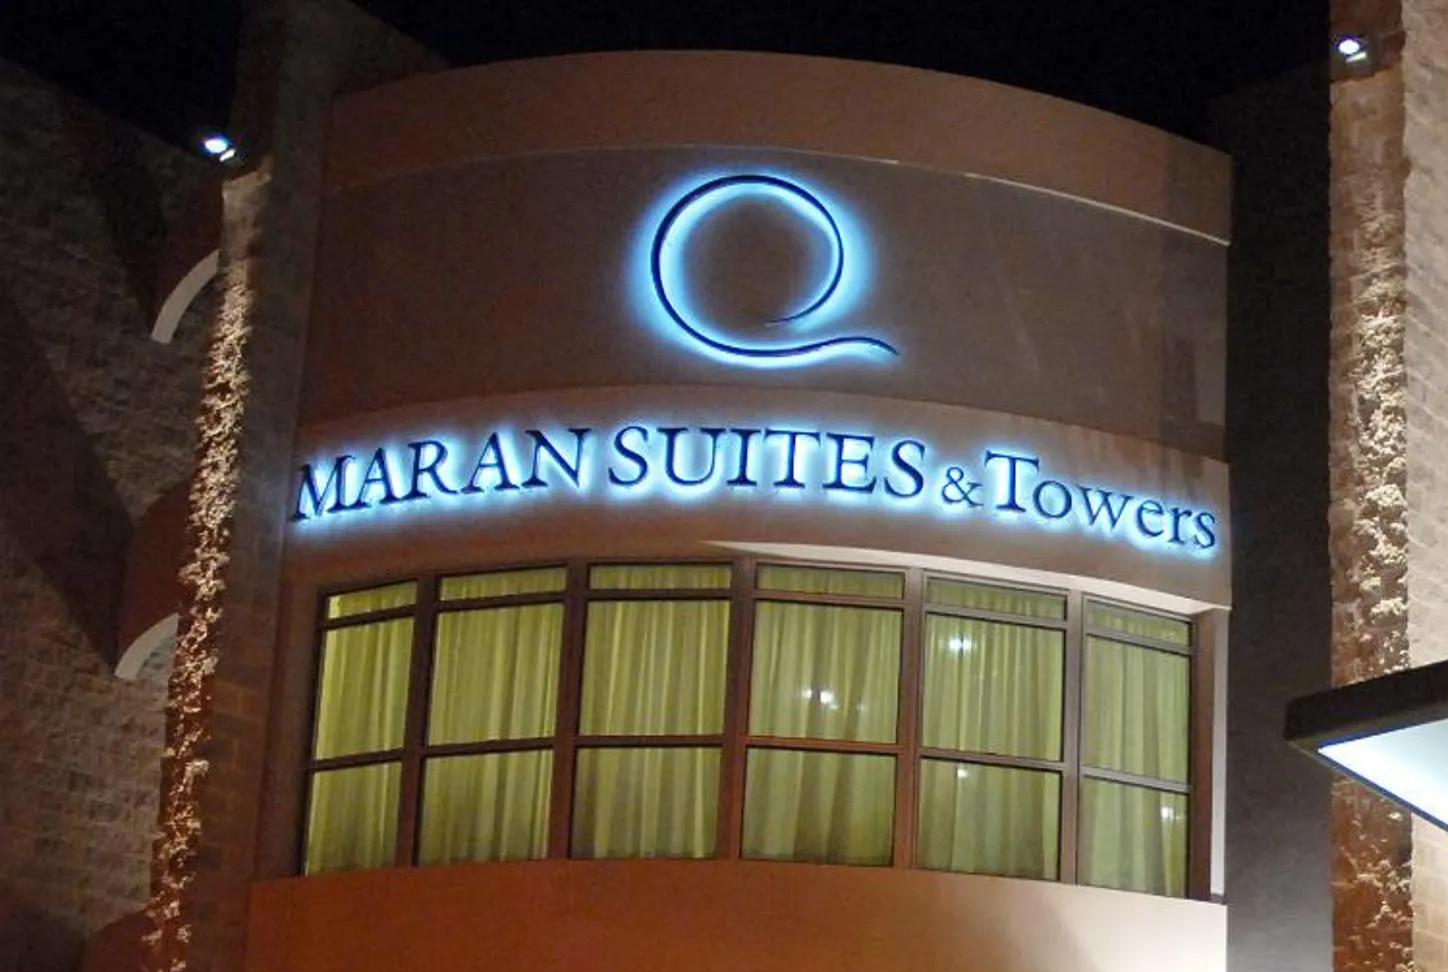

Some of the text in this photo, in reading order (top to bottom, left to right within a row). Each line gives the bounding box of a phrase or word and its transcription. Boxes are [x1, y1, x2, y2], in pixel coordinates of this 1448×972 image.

[289, 425, 1217, 552] MARAN SUITES & Towers
